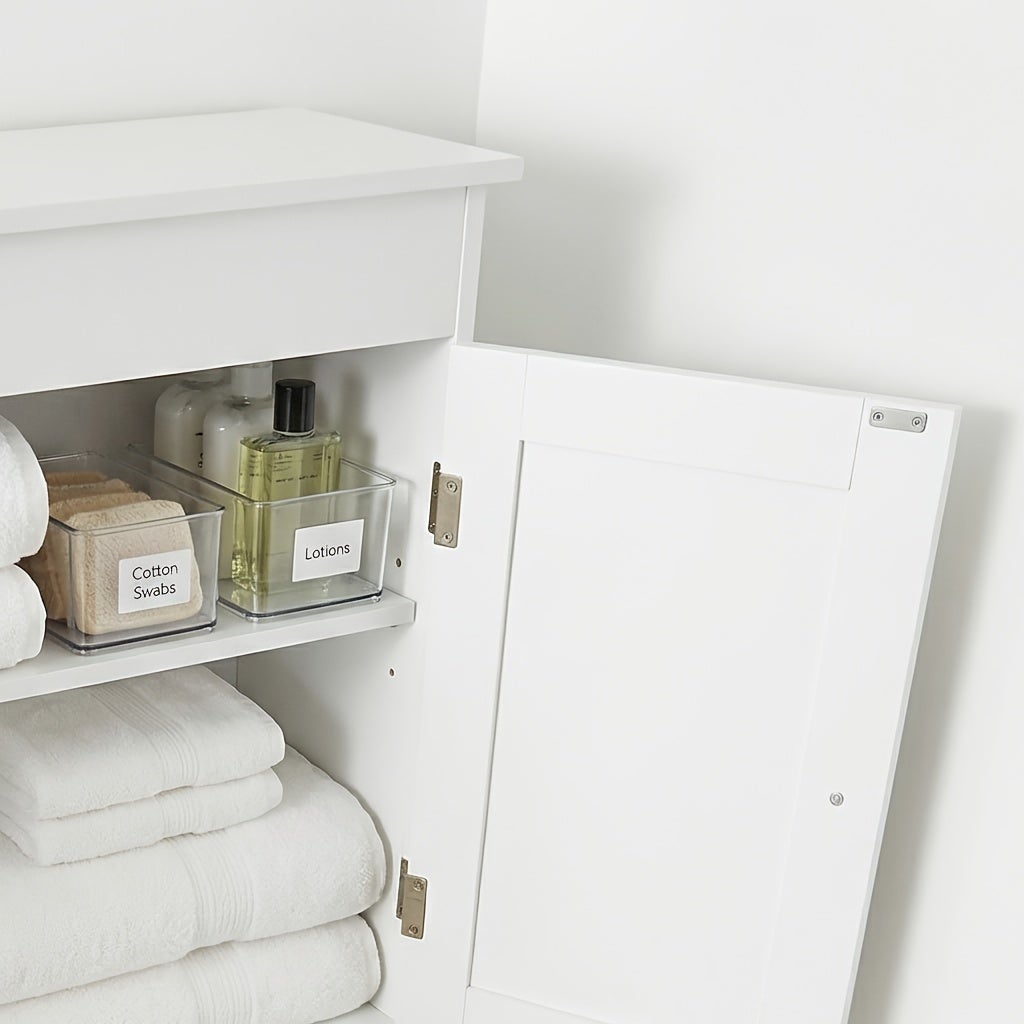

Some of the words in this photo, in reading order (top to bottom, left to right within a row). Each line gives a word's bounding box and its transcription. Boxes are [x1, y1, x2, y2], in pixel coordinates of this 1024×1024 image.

[305, 543, 351, 561] Lotions
[132, 563, 178, 581] Cotton
[134, 583, 176, 600] Swabs
